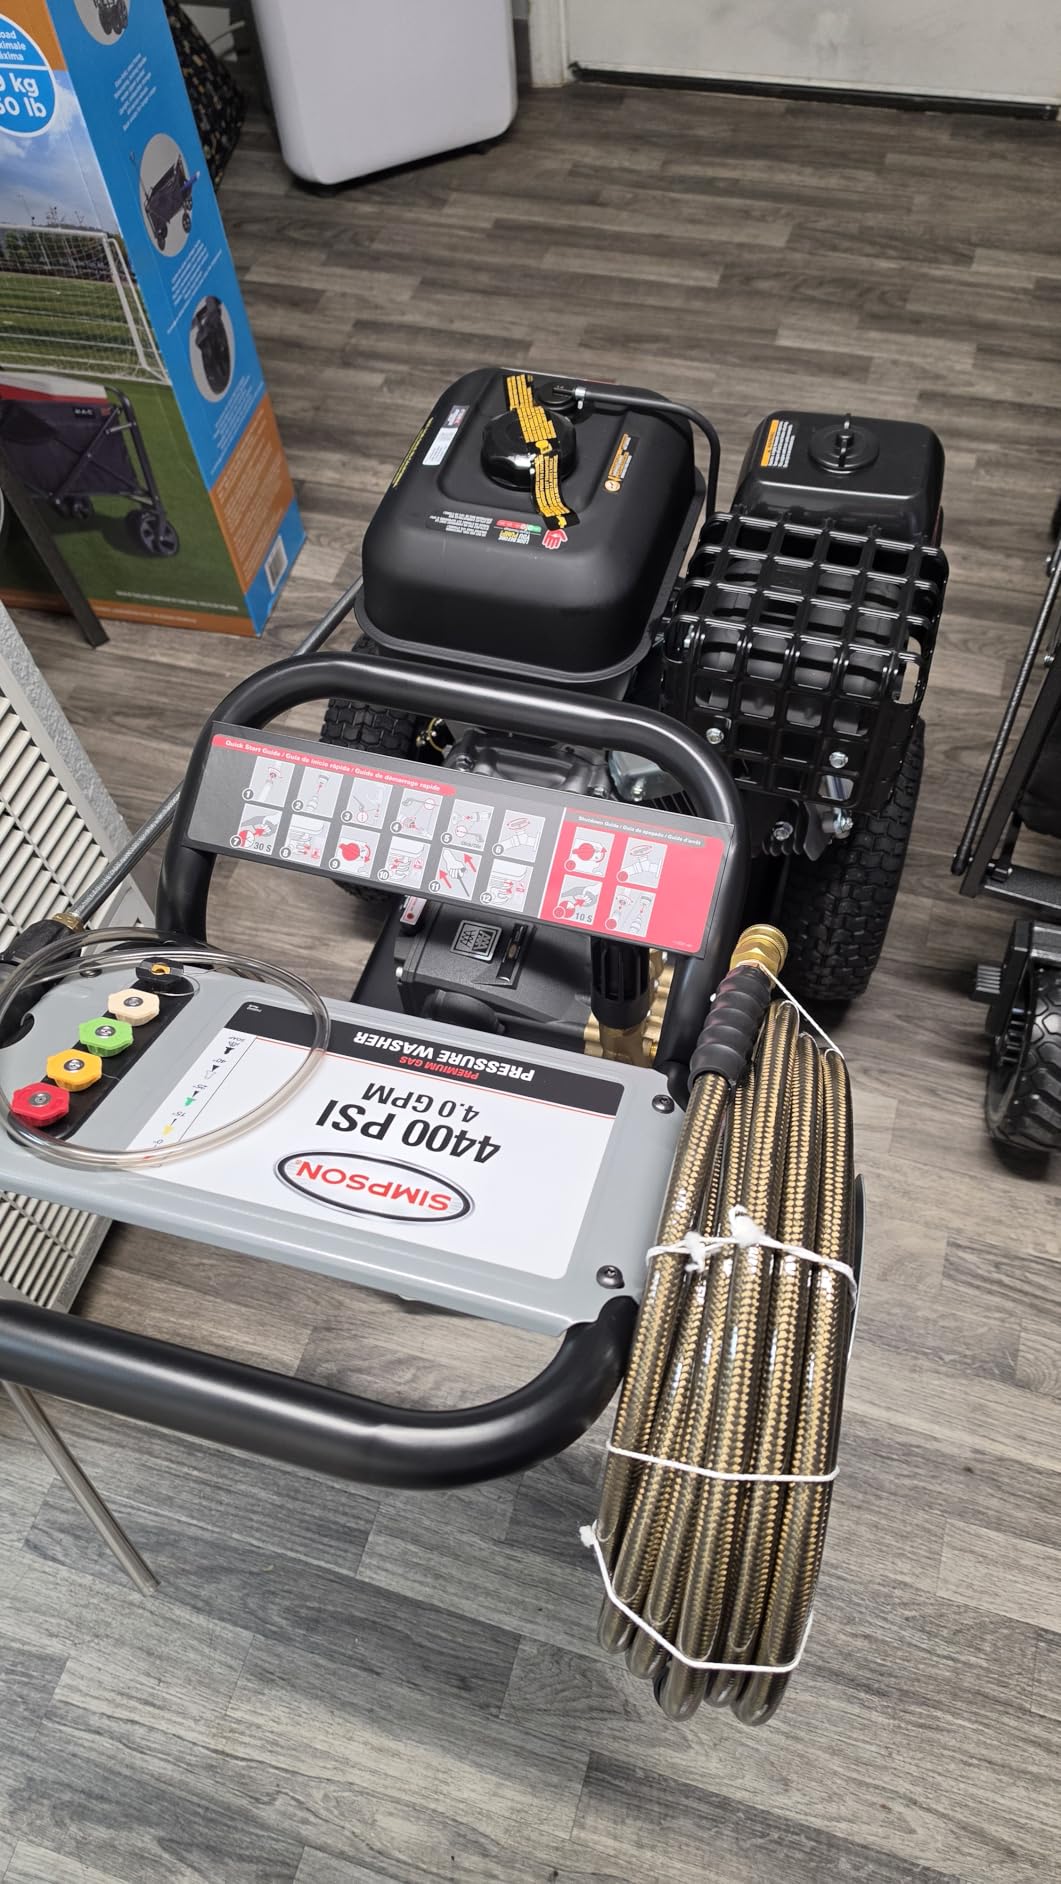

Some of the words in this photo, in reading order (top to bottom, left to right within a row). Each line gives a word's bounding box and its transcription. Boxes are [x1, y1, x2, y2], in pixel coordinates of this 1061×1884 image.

[9, 72, 39, 98] kg
[24, 96, 46, 118] lb
[226, 740, 243, 749] Quick
[245, 744, 261, 752] Start
[262, 748, 280, 757] Guide
[310, 759, 328, 767] inicio
[355, 768, 374, 777] Guide
[420, 782, 440, 792] rapide
[254, 842, 264, 852] 30
[266, 844, 272, 852] S
[668, 834, 682, 842] Guide
[576, 912, 585, 922] 10
[353, 1031, 434, 1061] WASHER
[399, 1055, 423, 1068] GAS
[424, 1059, 480, 1081] PREMIUM
[438, 1049, 536, 1082] PRESSURE
[361, 1082, 434, 1113] GPM
[315, 1099, 397, 1141] PSI
[438, 1099, 480, 1123] 4.0
[401, 1119, 502, 1164] 4400
[295, 1160, 453, 1212] SIMPSON
